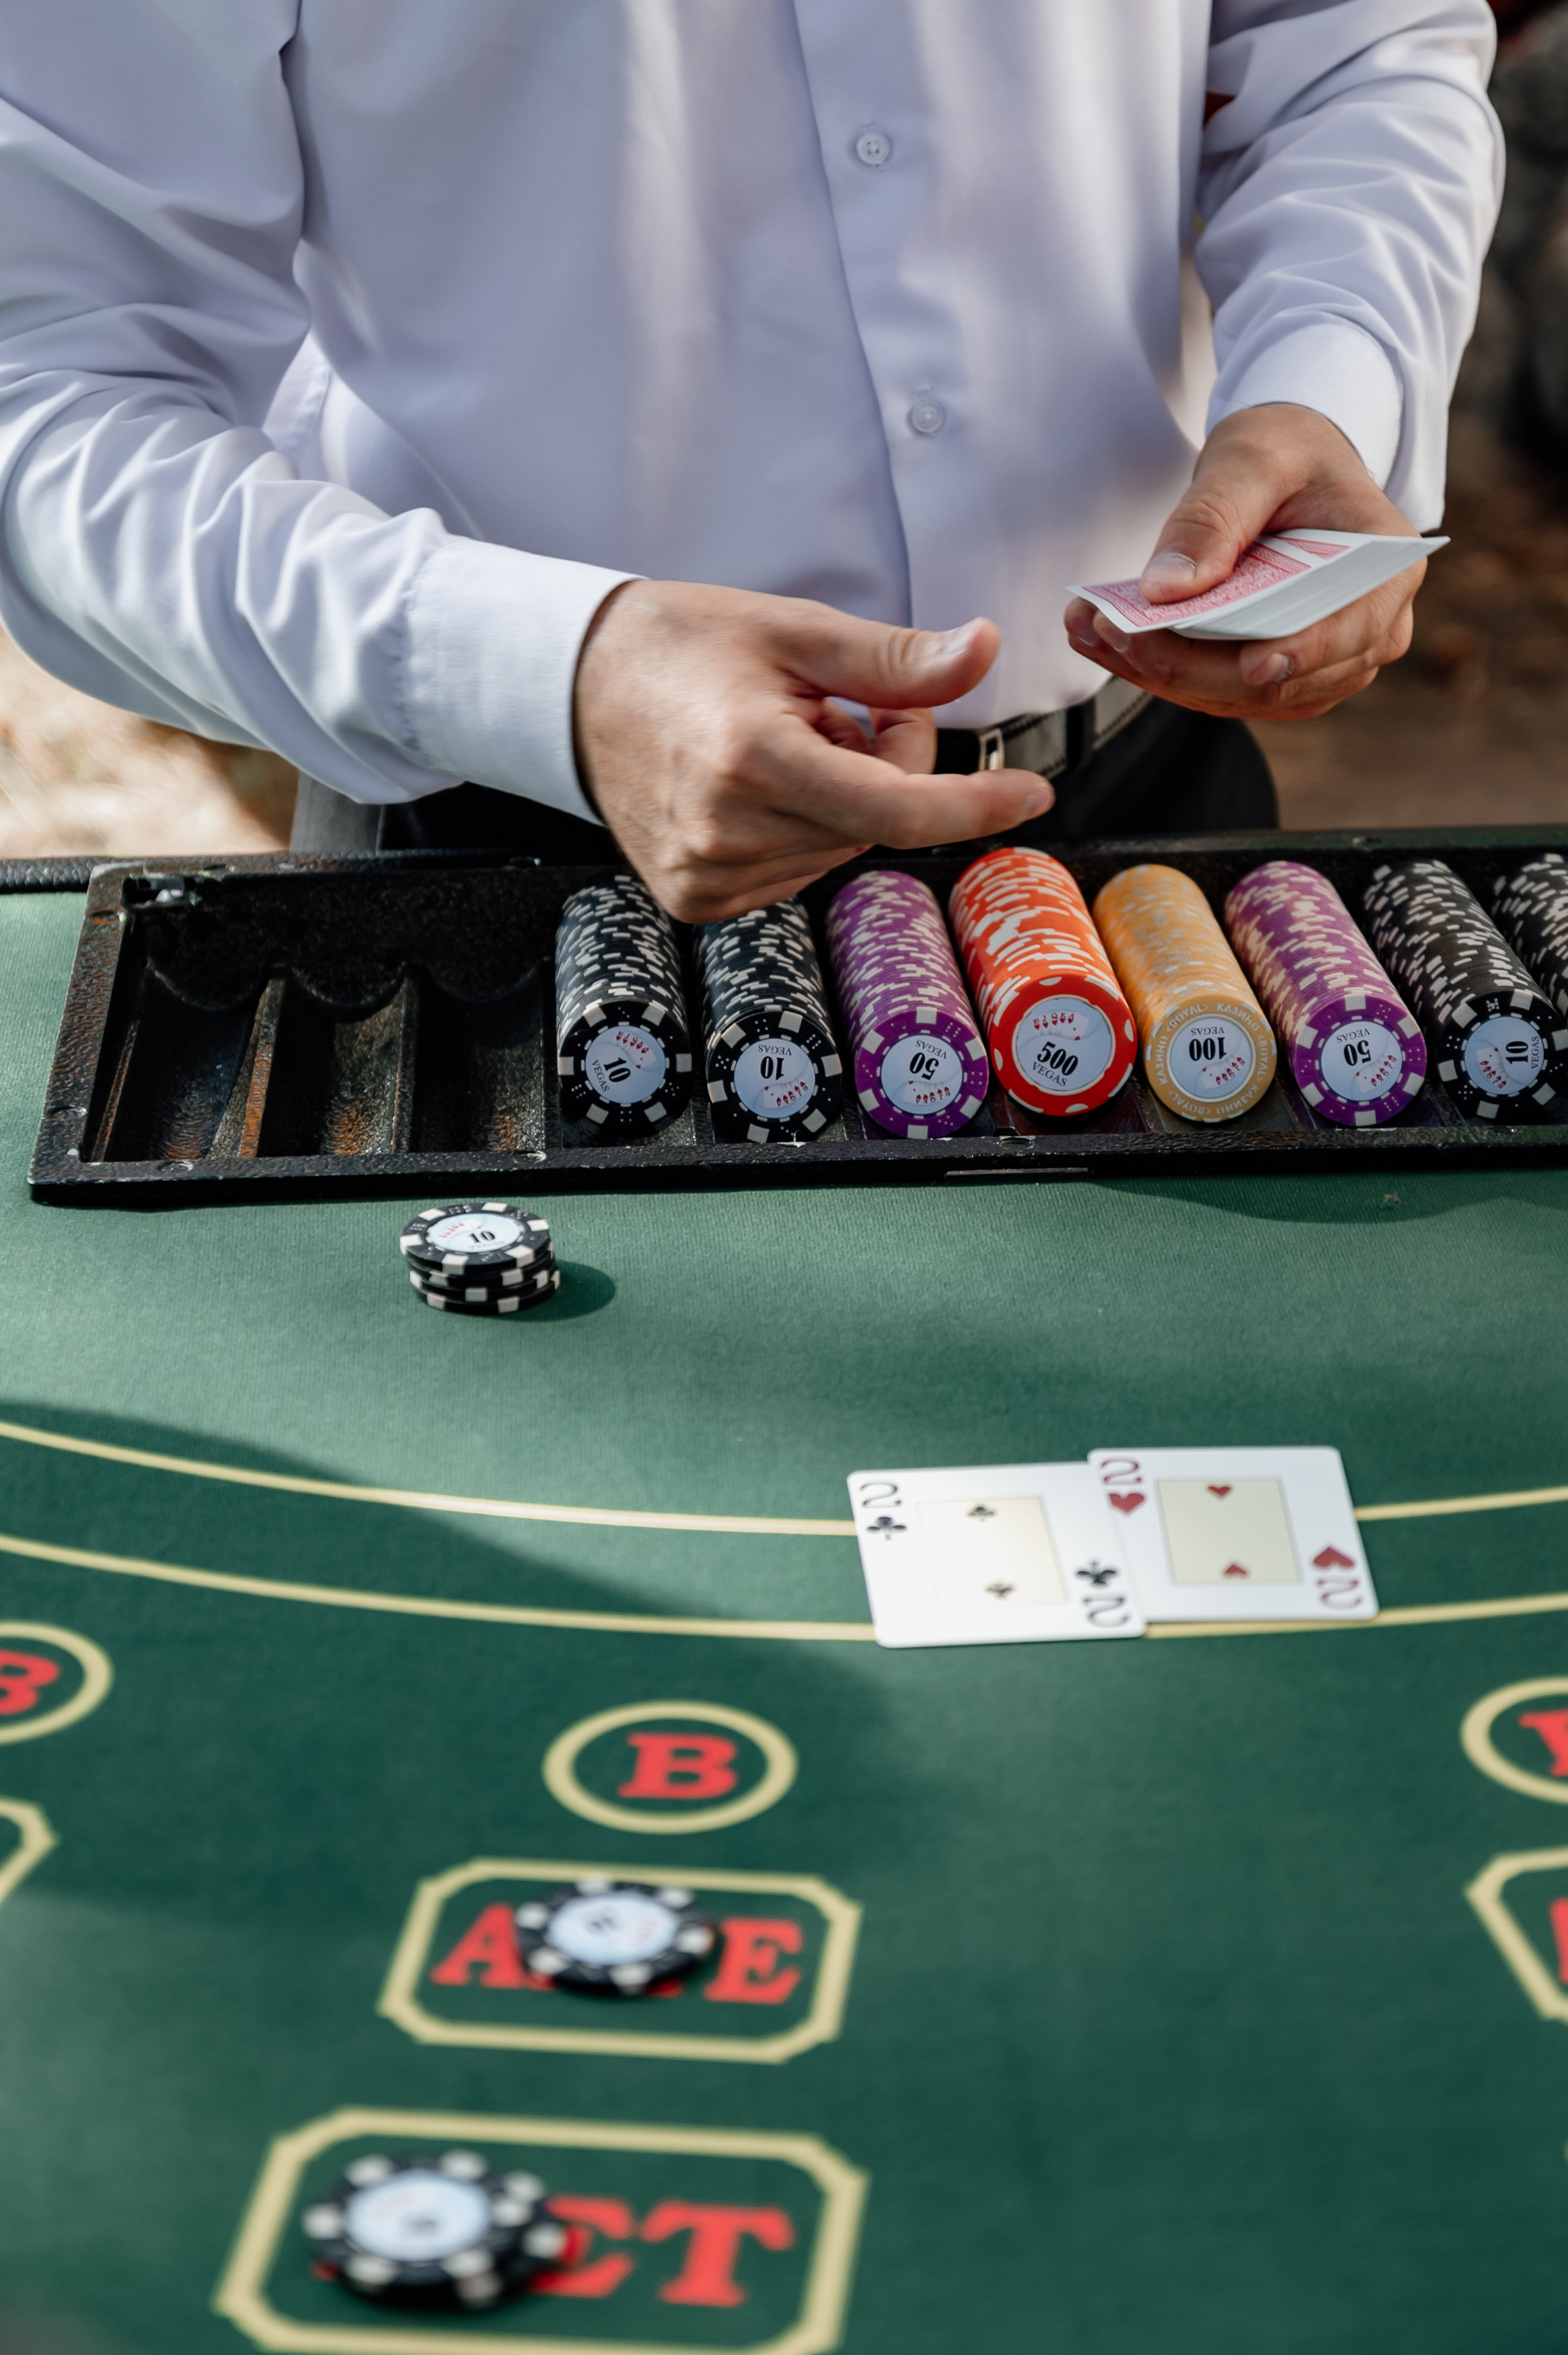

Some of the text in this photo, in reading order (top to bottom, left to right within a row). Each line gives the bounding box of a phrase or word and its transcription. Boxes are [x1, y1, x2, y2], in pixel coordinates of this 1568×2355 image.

[1191, 1026, 1225, 1036] VEGAS
[1336, 1028, 1370, 1043] VEGAS
[758, 1044, 792, 1056] VEGAS
[915, 1039, 947, 1059] VEGAS
[1037, 1041, 1078, 1076] 500
[1189, 1037, 1227, 1061] 100
[1344, 1040, 1372, 1066] 50
[1505, 1041, 1528, 1064] 10
[592, 1059, 609, 1092] VEGAS
[603, 1057, 631, 1083] 10
[760, 1056, 784, 1081] 10
[909, 1052, 939, 1081] 50
[1033, 1061, 1068, 1087] VEGAS
[468, 1231, 496, 1243] 10
[1100, 1457, 1143, 1486] 2
[859, 1482, 903, 1509] 2
[1316, 1579, 1364, 1611] 2
[1082, 1595, 1130, 1628] 2
[618, 1731, 737, 1800] B
